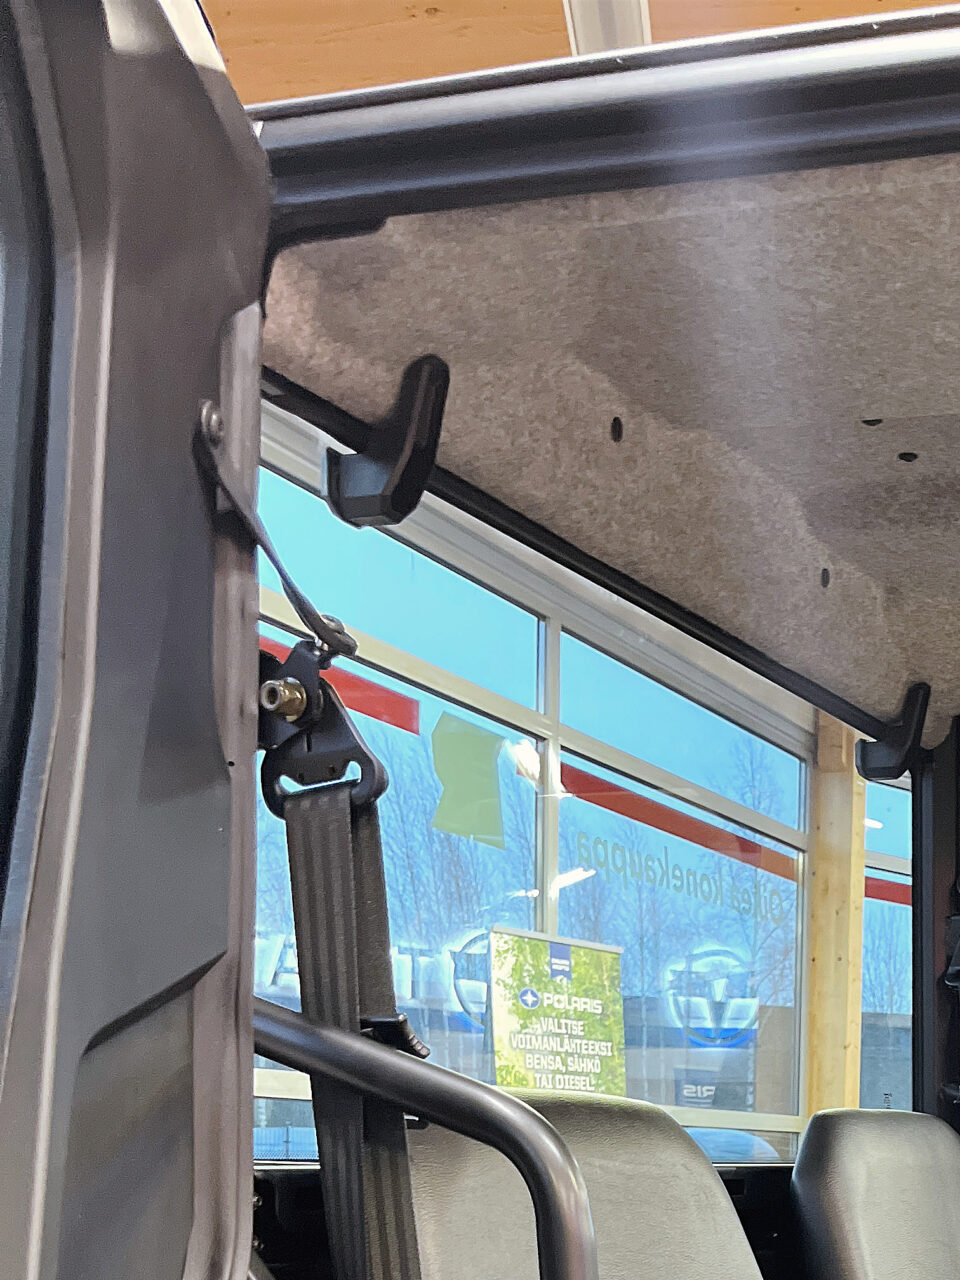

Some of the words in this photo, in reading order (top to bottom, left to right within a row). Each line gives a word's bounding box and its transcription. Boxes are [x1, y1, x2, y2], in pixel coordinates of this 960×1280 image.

[543, 992, 603, 1014] POLARIS
[540, 1017, 585, 1036] VALITSE
[510, 1034, 613, 1057] VOIMANLÄHTEEKSI
[526, 1054, 566, 1073] BENSA,
[567, 1056, 601, 1074] SÄHKÖ
[534, 1073, 555, 1089] TAI
